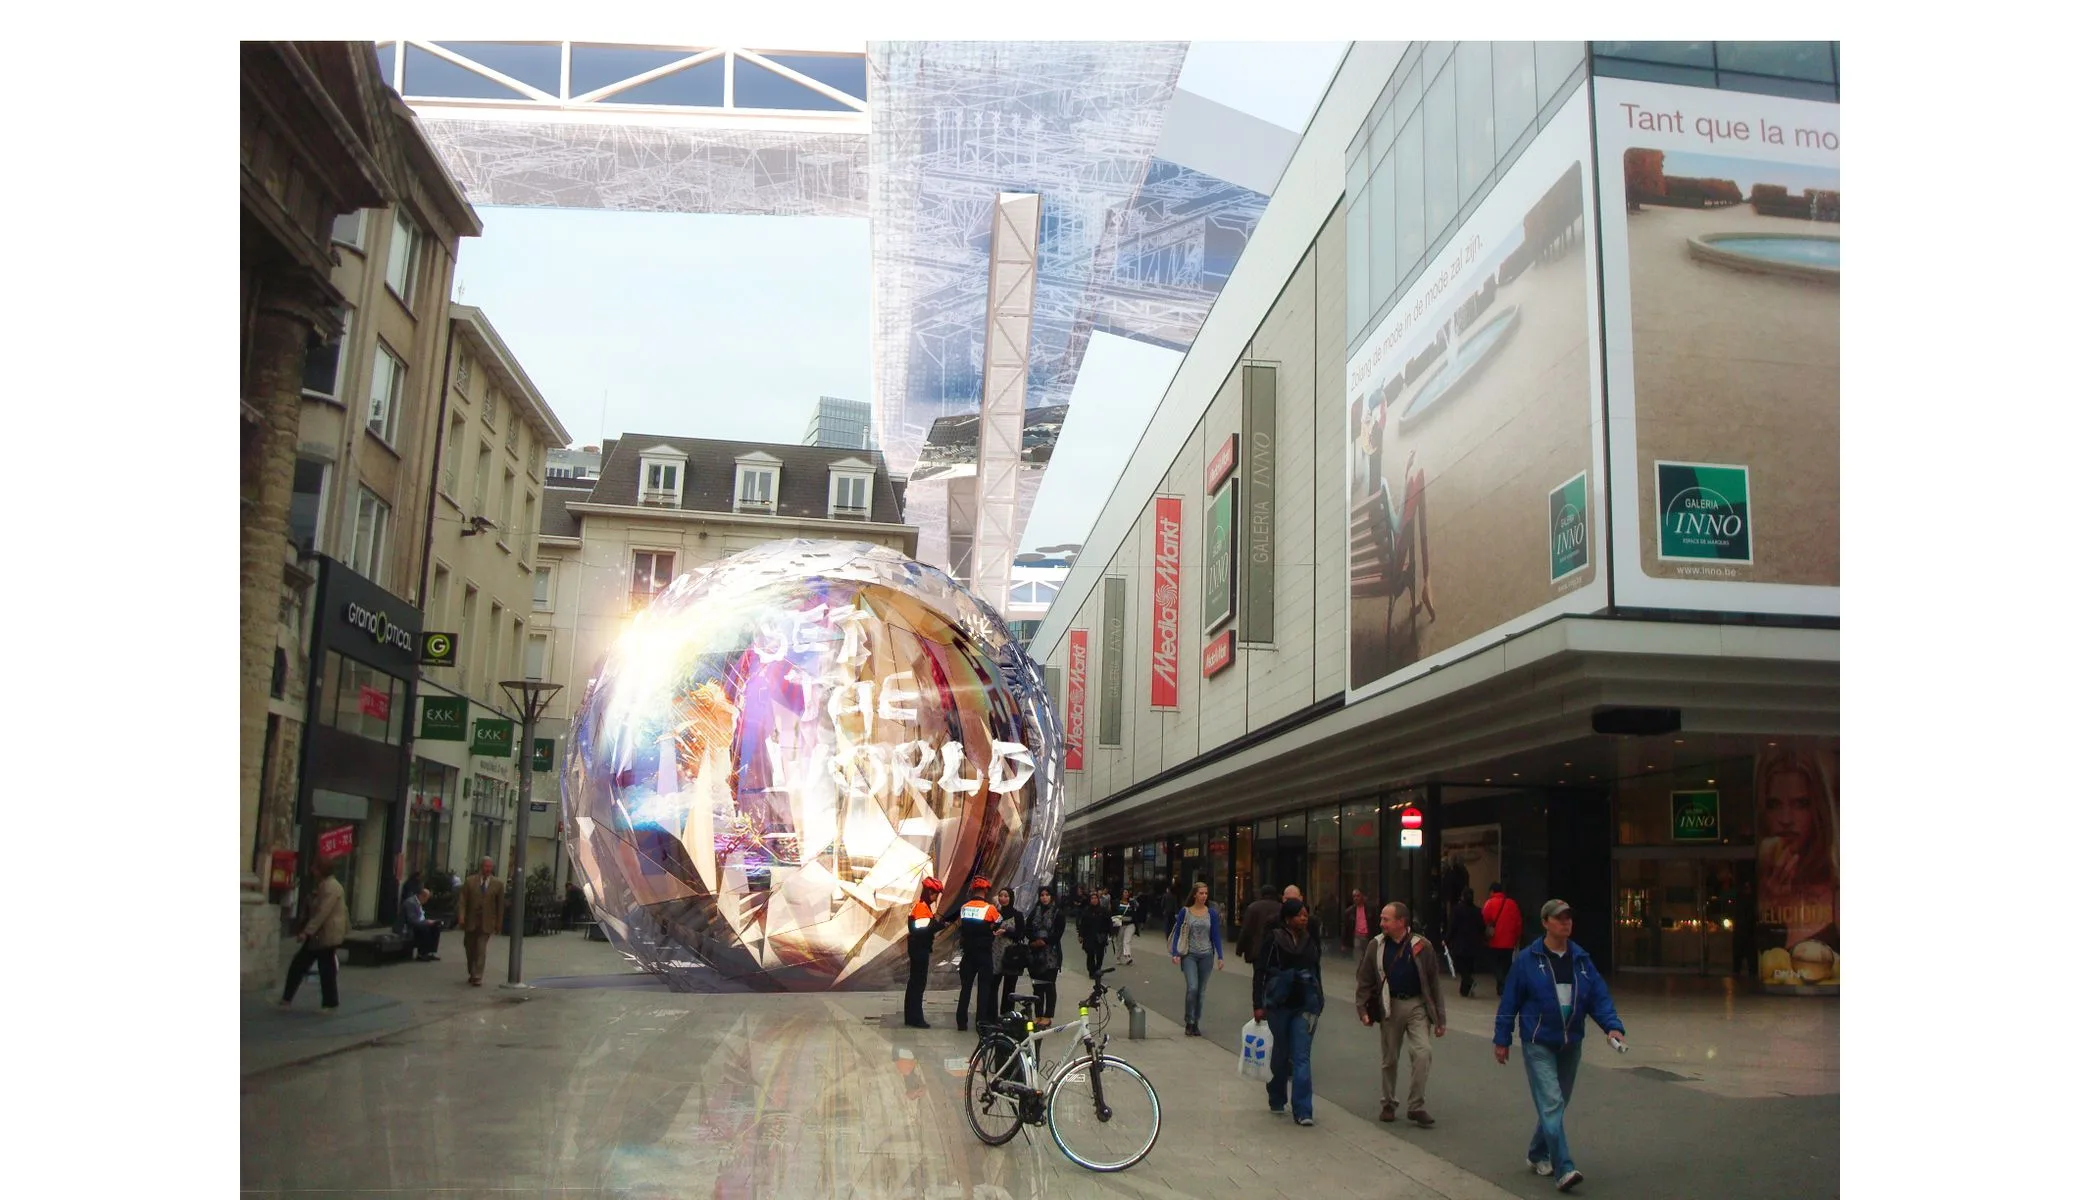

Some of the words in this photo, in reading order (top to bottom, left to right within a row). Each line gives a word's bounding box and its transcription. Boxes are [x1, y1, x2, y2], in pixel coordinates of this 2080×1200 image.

[1619, 103, 1685, 134] Tant
[1695, 117, 1750, 143] que
[1760, 119, 1785, 145] la
[1374, 345, 1382, 366] de
[1404, 311, 1412, 333] in
[1413, 299, 1423, 321] de
[1425, 271, 1449, 309] mode
[1450, 248, 1463, 280] zal
[1465, 234, 1483, 264] zijn.
[1253, 431, 1271, 488] INNO
[1674, 512, 1742, 537] INNO
[1685, 498, 1719, 510] GALERIA
[1155, 517, 1179, 588] Markt
[1253, 501, 1270, 563] GALERIA
[1557, 522, 1584, 555] INNO
[1208, 552, 1229, 596] INNO
[1676, 567, 1737, 577] www.inno.be
[432, 638, 446, 653] G
[1154, 607, 1178, 688] Media
[1680, 815, 1715, 828] INNO
